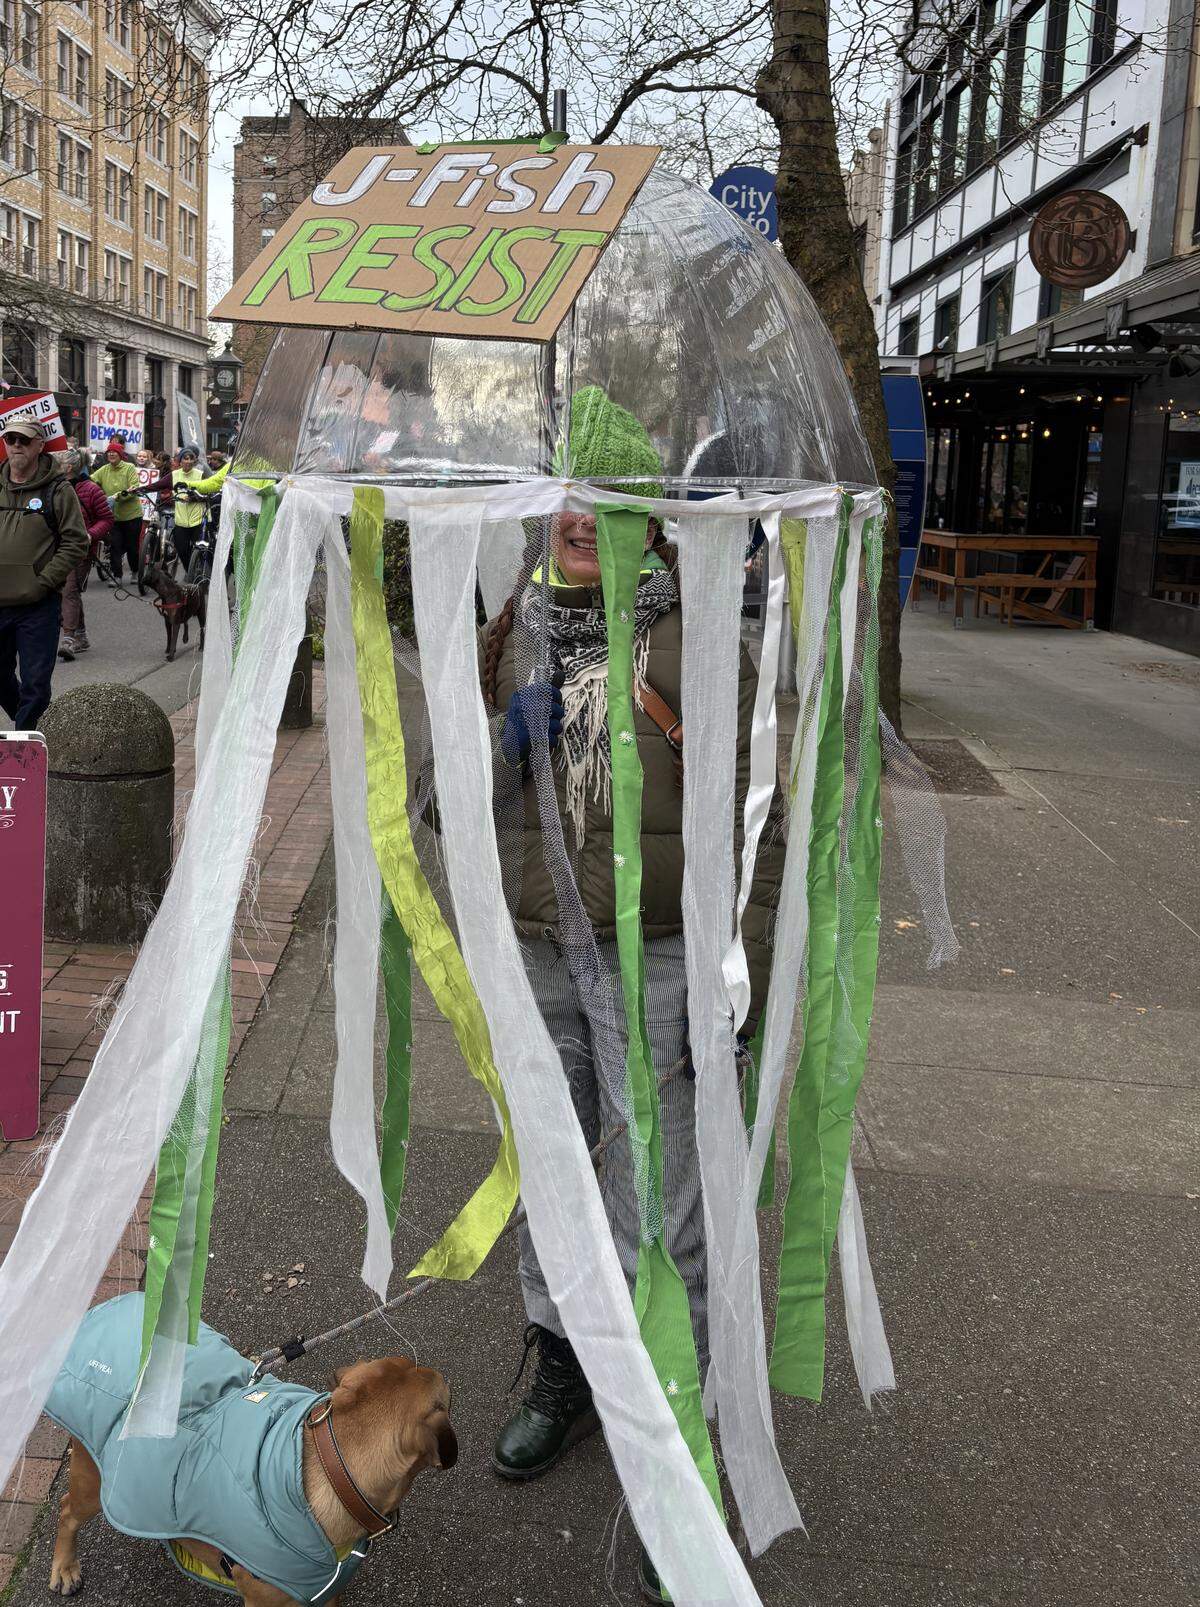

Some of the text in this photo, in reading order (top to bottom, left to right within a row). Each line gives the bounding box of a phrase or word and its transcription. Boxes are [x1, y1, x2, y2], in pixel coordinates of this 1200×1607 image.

[721, 184, 773, 215] City
[240, 217, 611, 324] RESIST
[40, 399, 51, 413] IS
